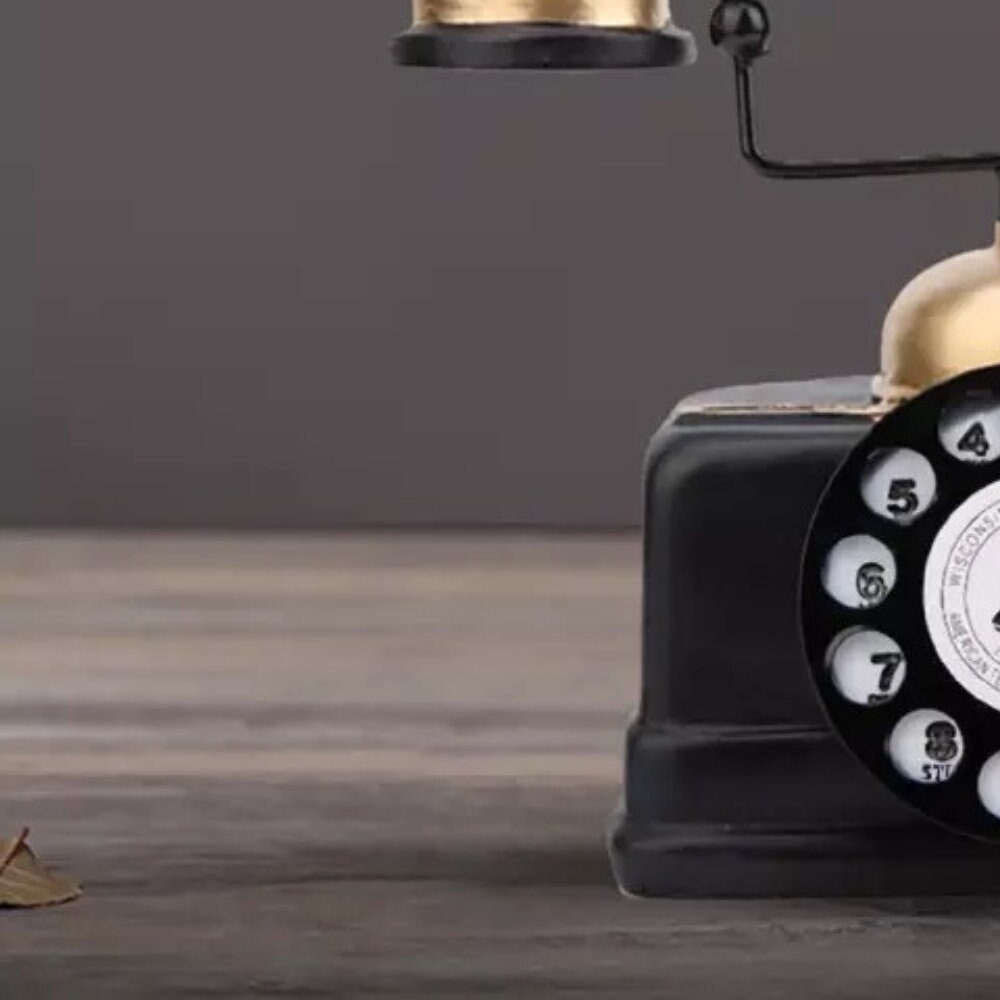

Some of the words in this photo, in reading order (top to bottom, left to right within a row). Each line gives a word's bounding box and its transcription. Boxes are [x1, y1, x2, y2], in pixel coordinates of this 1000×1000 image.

[958, 421, 990, 457] 4
[887, 478, 919, 515] 5
[856, 562, 888, 600] 6
[870, 653, 902, 691] 7
[925, 720, 959, 762] 8
